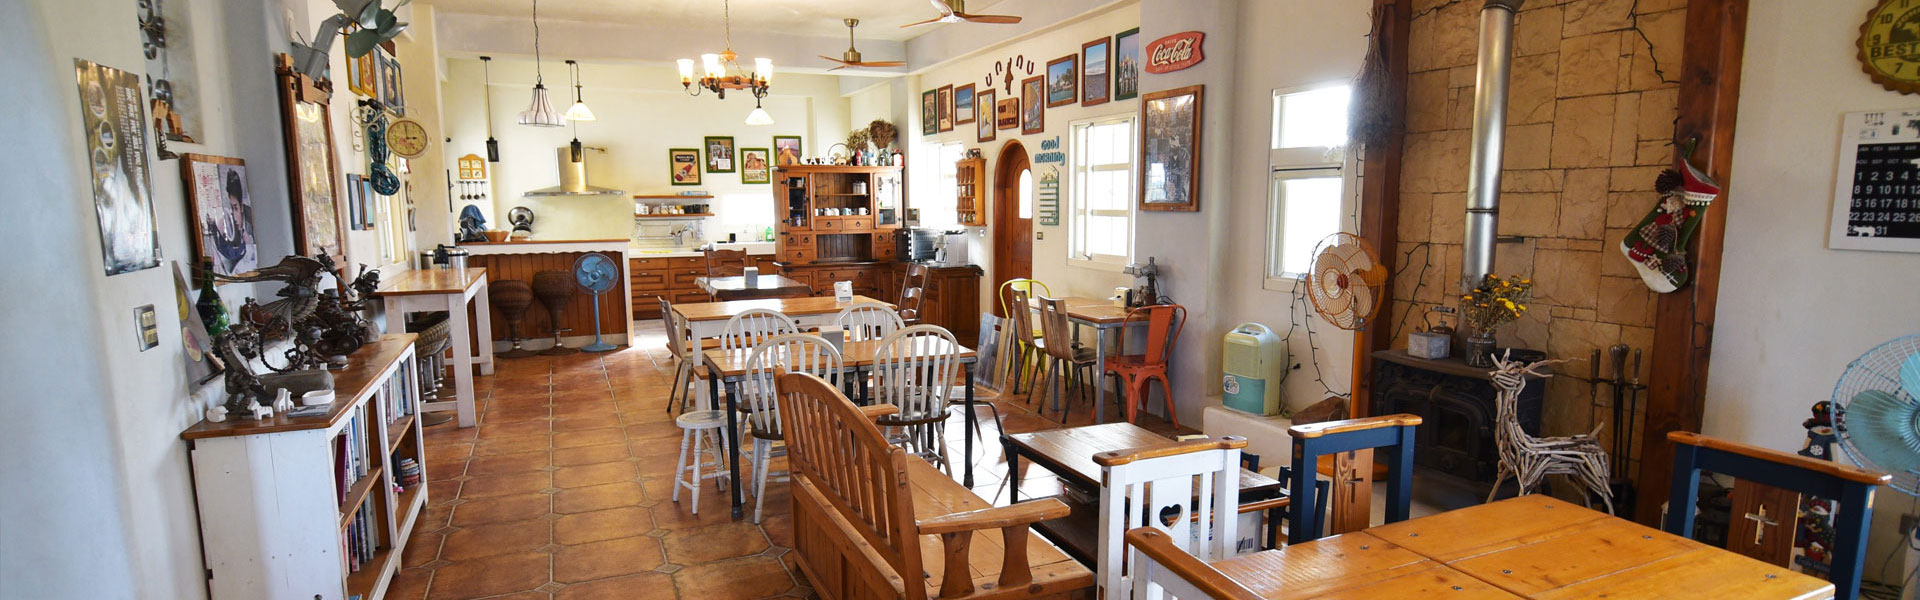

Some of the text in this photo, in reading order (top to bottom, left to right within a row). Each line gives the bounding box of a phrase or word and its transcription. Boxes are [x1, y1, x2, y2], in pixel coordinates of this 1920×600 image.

[1881, 13, 1893, 24] 10
[1151, 37, 1196, 67] Coca-Cola
[1870, 43, 1919, 58] BEST
[1895, 62, 1904, 74] 7
[1857, 171, 1909, 181] 1 2 3 4
[1854, 185, 1861, 194] 8
[1866, 185, 1873, 194] 9
[1879, 185, 1891, 194] 10
[1894, 185, 1906, 194] 11
[1850, 198, 1862, 208] 15
[1865, 198, 1877, 208] 16
[1880, 199, 1893, 208] 17
[1896, 199, 1908, 208] 18
[1849, 211, 1920, 222] 22 23 24 25 26
[1875, 226, 1887, 235] 31
